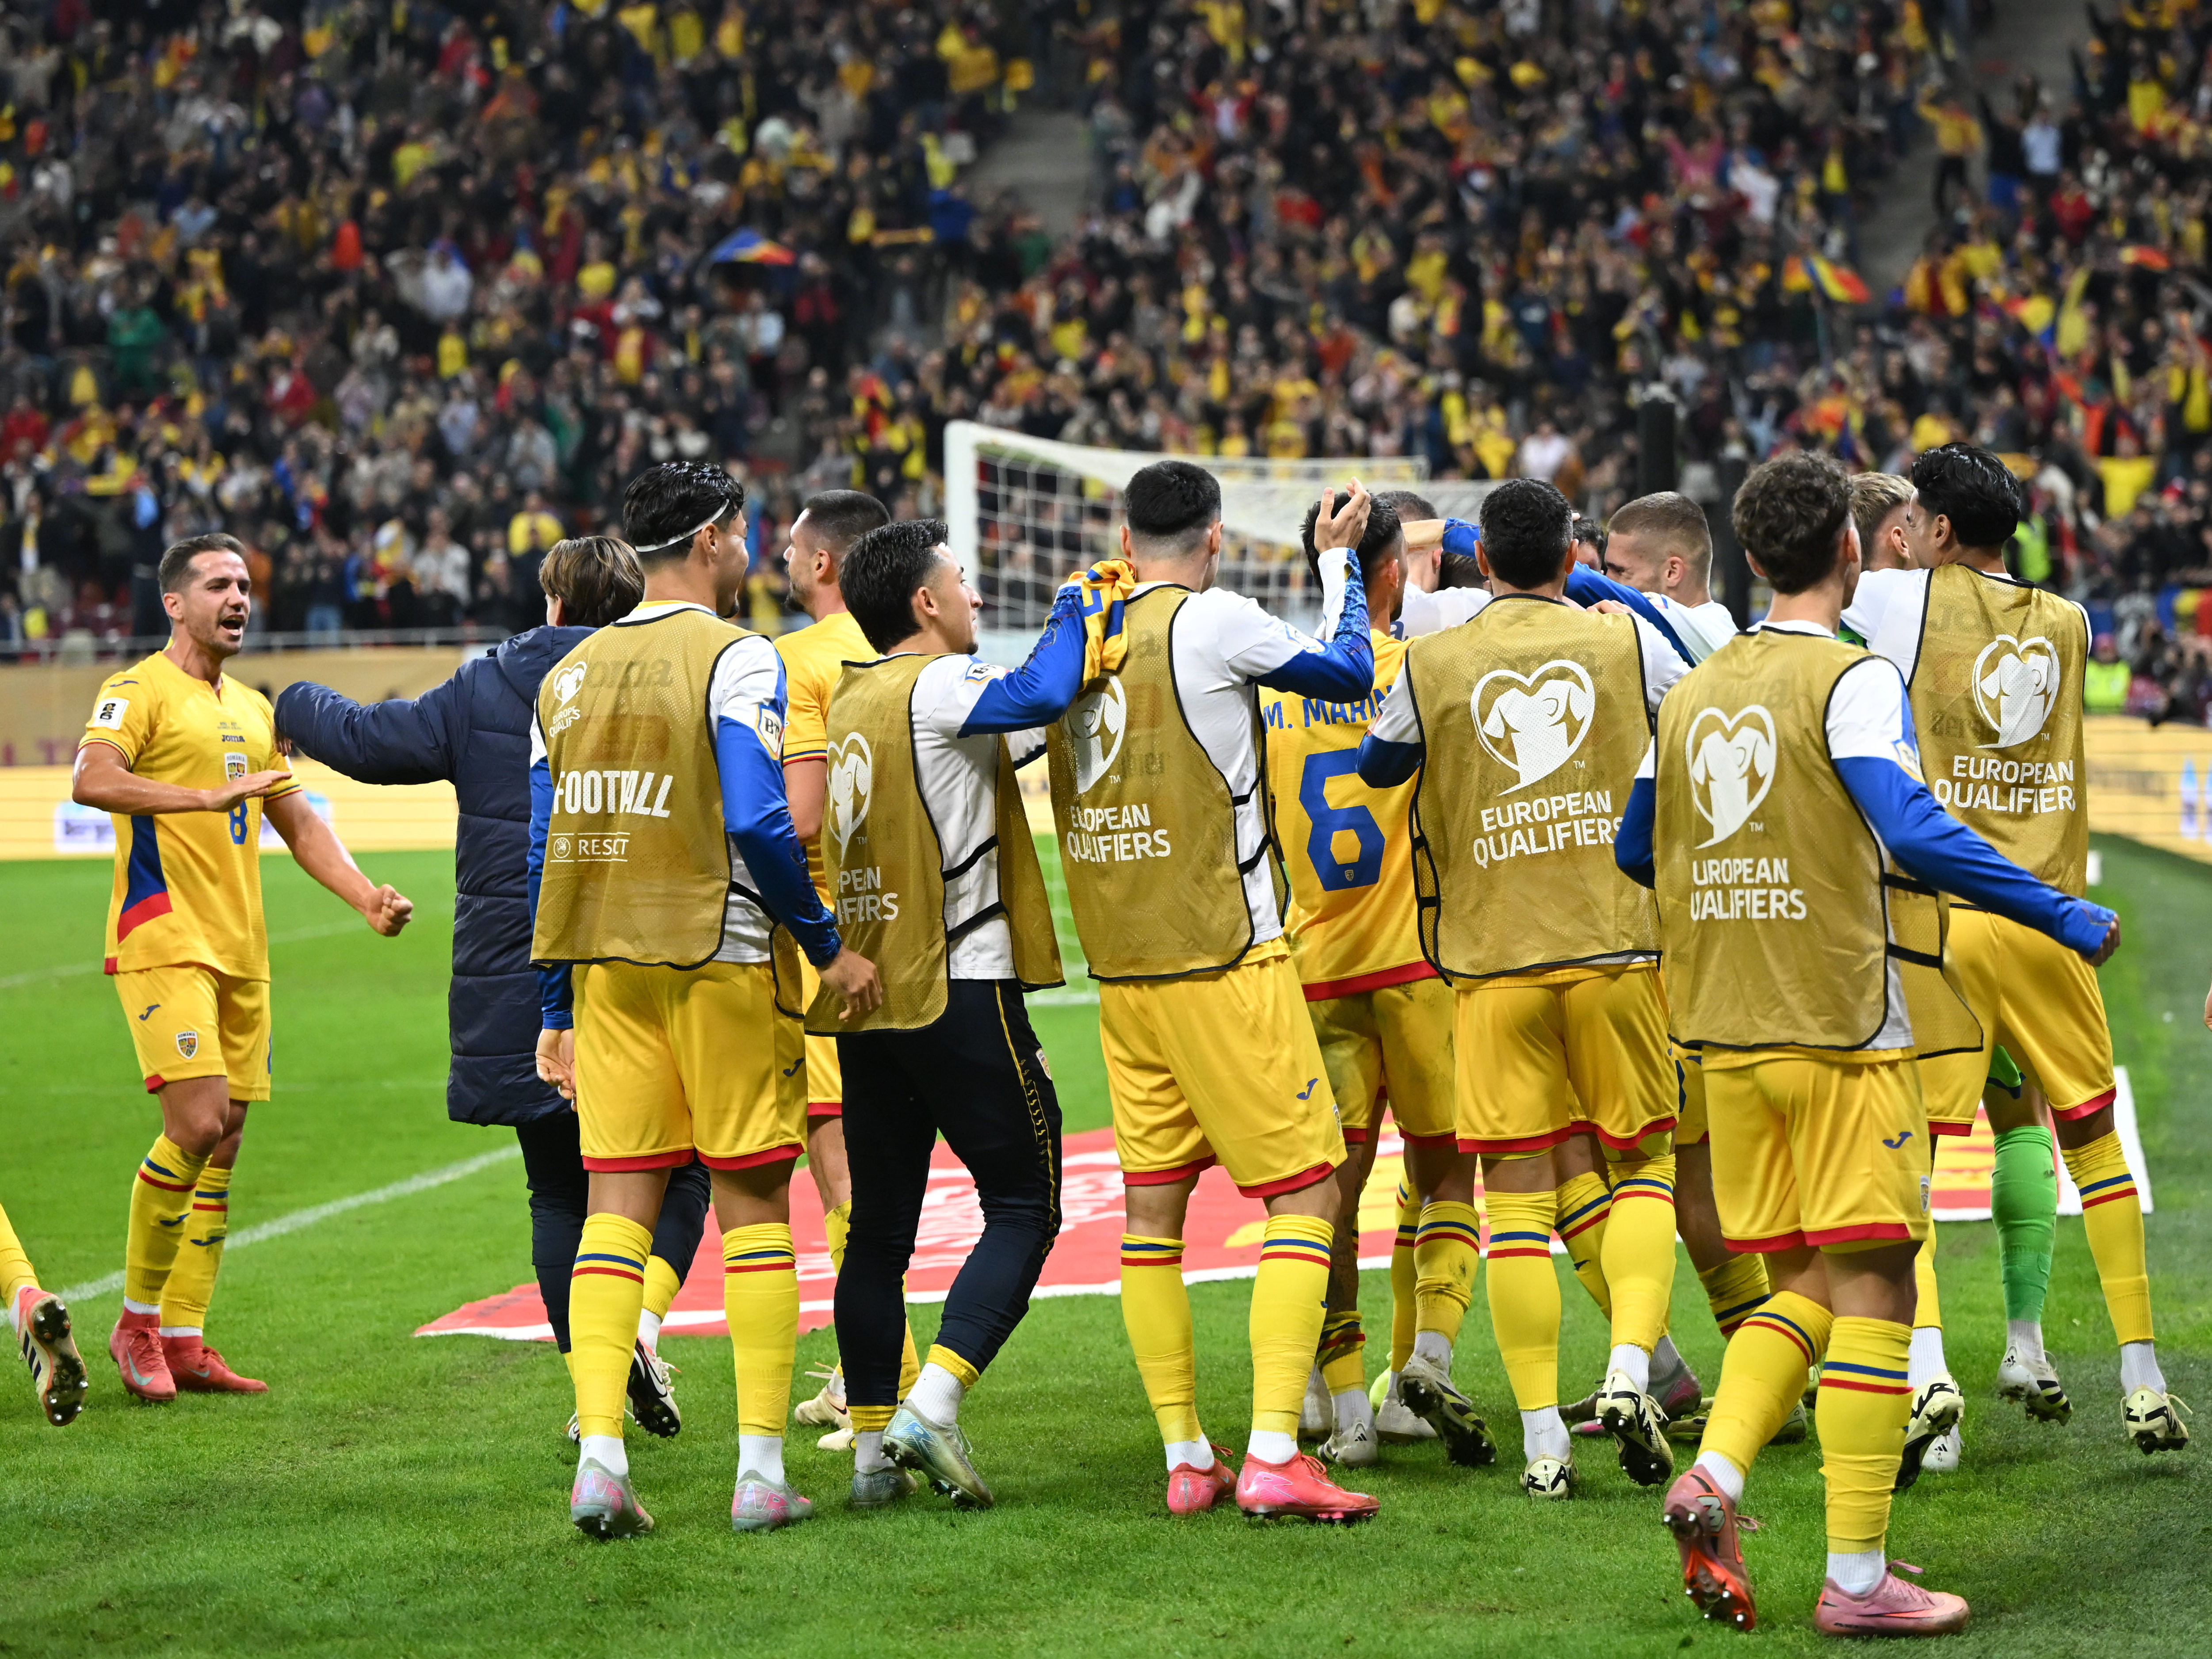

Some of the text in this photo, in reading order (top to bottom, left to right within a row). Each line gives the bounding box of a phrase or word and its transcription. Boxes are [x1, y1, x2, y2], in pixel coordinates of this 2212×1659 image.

[1263, 701, 1293, 734] M.
[1953, 755, 2074, 784] EUROPEAN
[1481, 790, 1612, 832] EUROPEAN
[1934, 778, 2076, 813] QUALIFIER
[228, 801, 248, 844] 8
[1299, 748, 1385, 892] 6
[1692, 858, 1790, 886] UROPEAN
[1690, 889, 1807, 921] UALIFIERS
